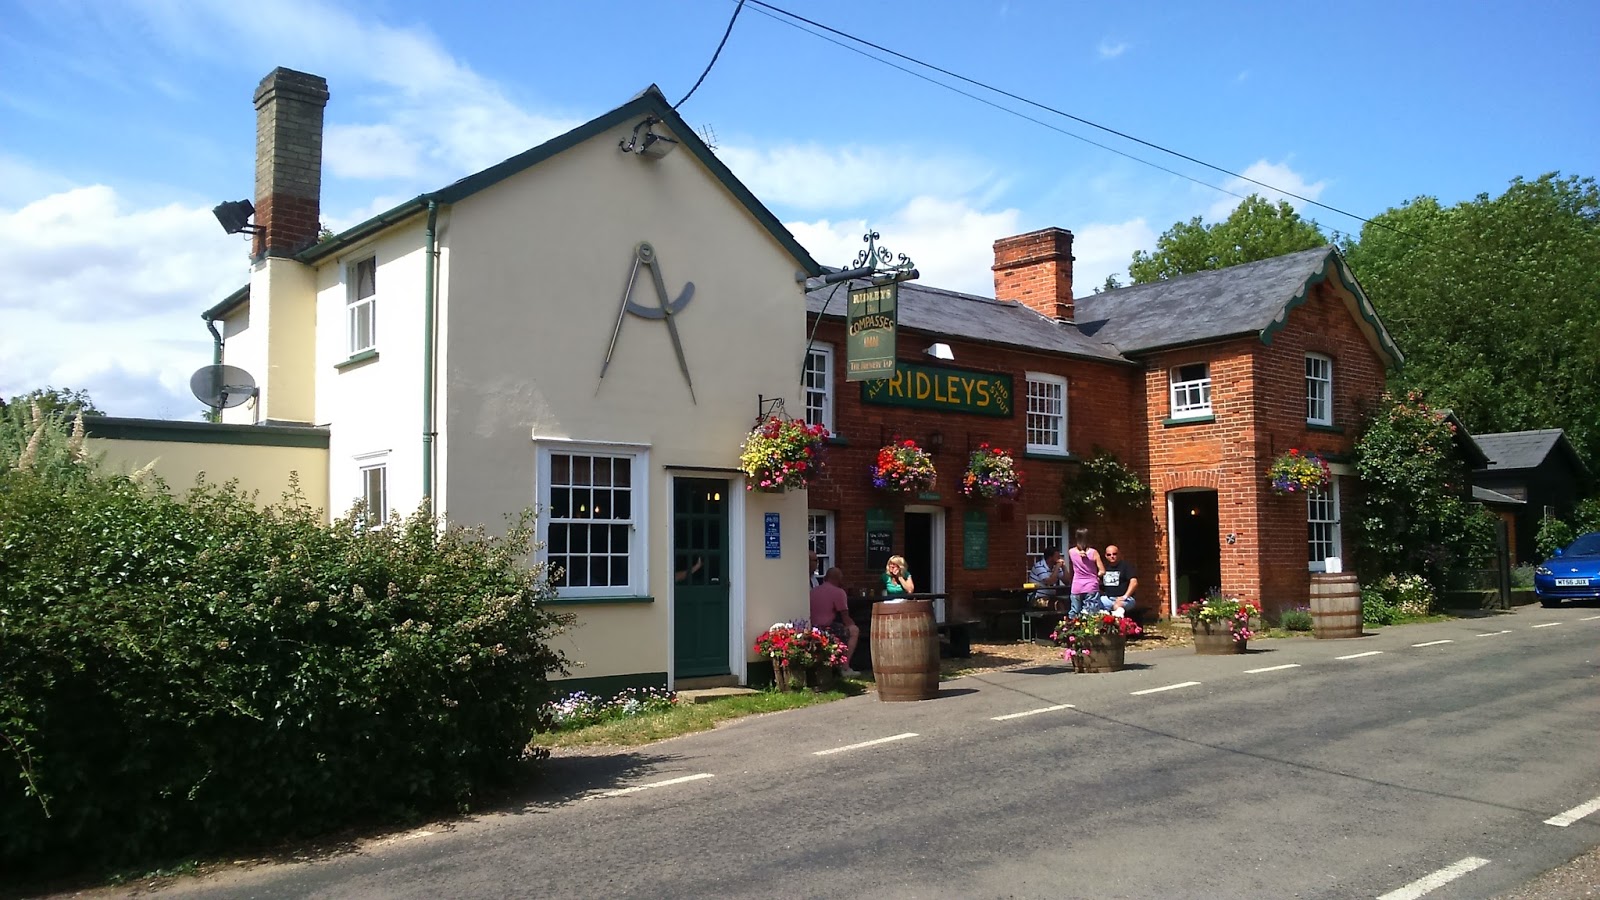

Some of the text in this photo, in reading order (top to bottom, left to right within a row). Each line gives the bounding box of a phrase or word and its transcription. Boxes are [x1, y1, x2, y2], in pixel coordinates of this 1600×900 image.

[853, 289, 892, 304] RIDLEYS
[849, 315, 894, 336] COMPASSES
[888, 370, 990, 407] RIDLEYS
[994, 379, 1009, 399] AND
[989, 385, 1009, 415] STOUT
